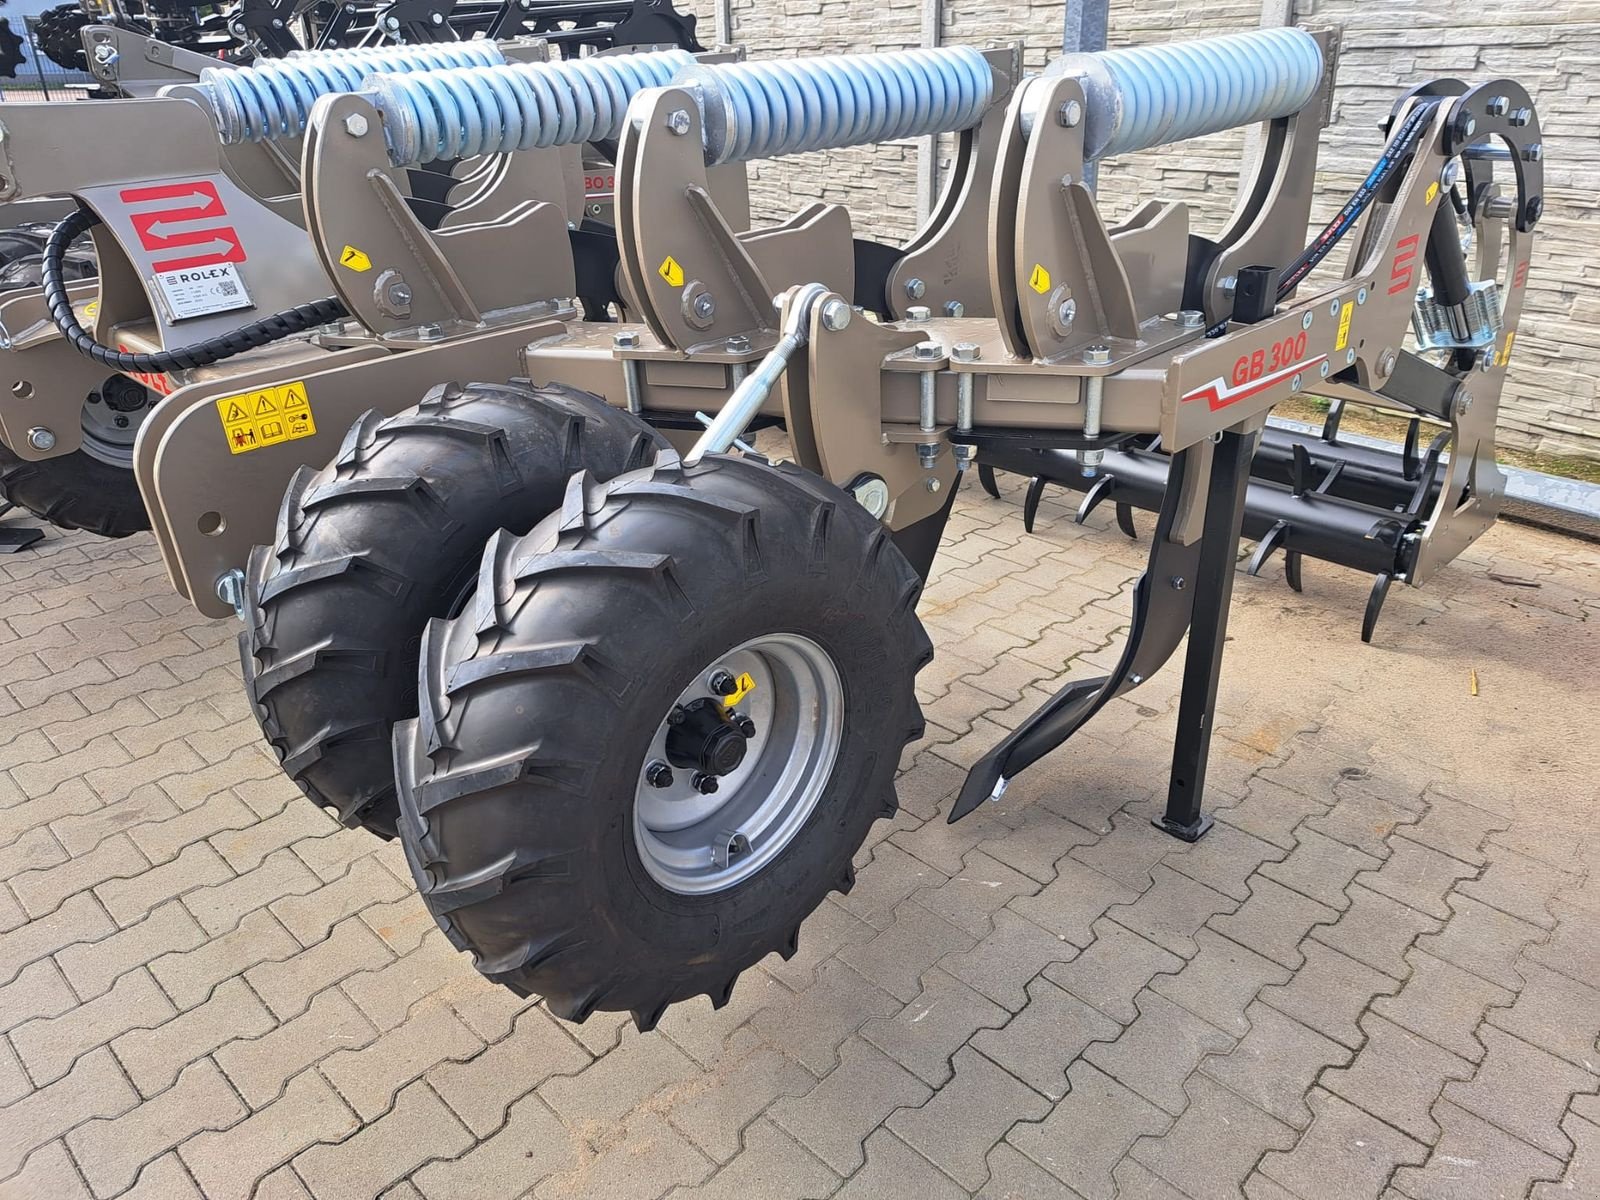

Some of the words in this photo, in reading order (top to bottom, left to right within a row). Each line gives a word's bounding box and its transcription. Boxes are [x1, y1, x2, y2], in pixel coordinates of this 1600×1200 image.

[180, 267, 230, 283] ROLEX
[1232, 349, 1265, 386] GB
[1268, 331, 1307, 372] 300
